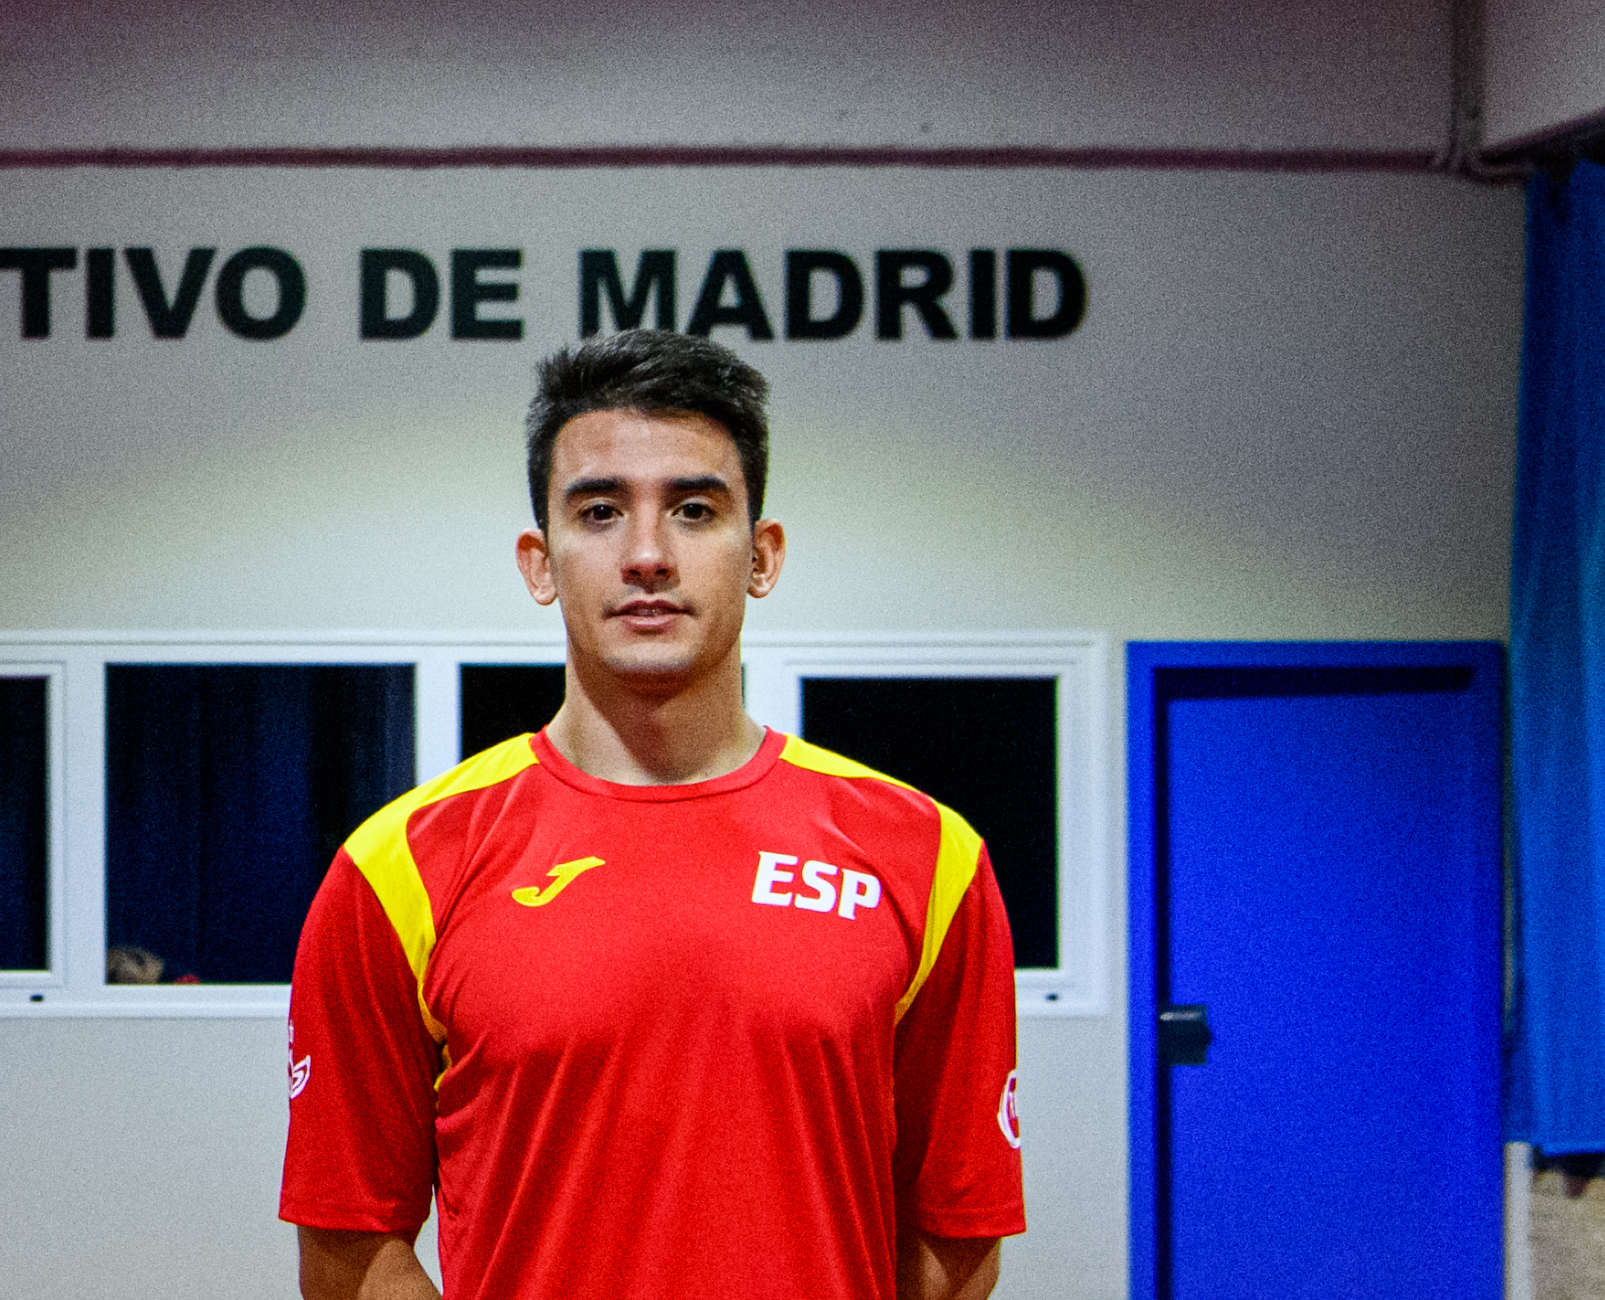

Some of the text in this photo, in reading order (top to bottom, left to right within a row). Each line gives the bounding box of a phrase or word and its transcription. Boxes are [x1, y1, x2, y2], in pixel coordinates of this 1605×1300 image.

[360, 248, 523, 340] DE
[578, 248, 1089, 341] MADRID
[751, 850, 882, 921] ESP
